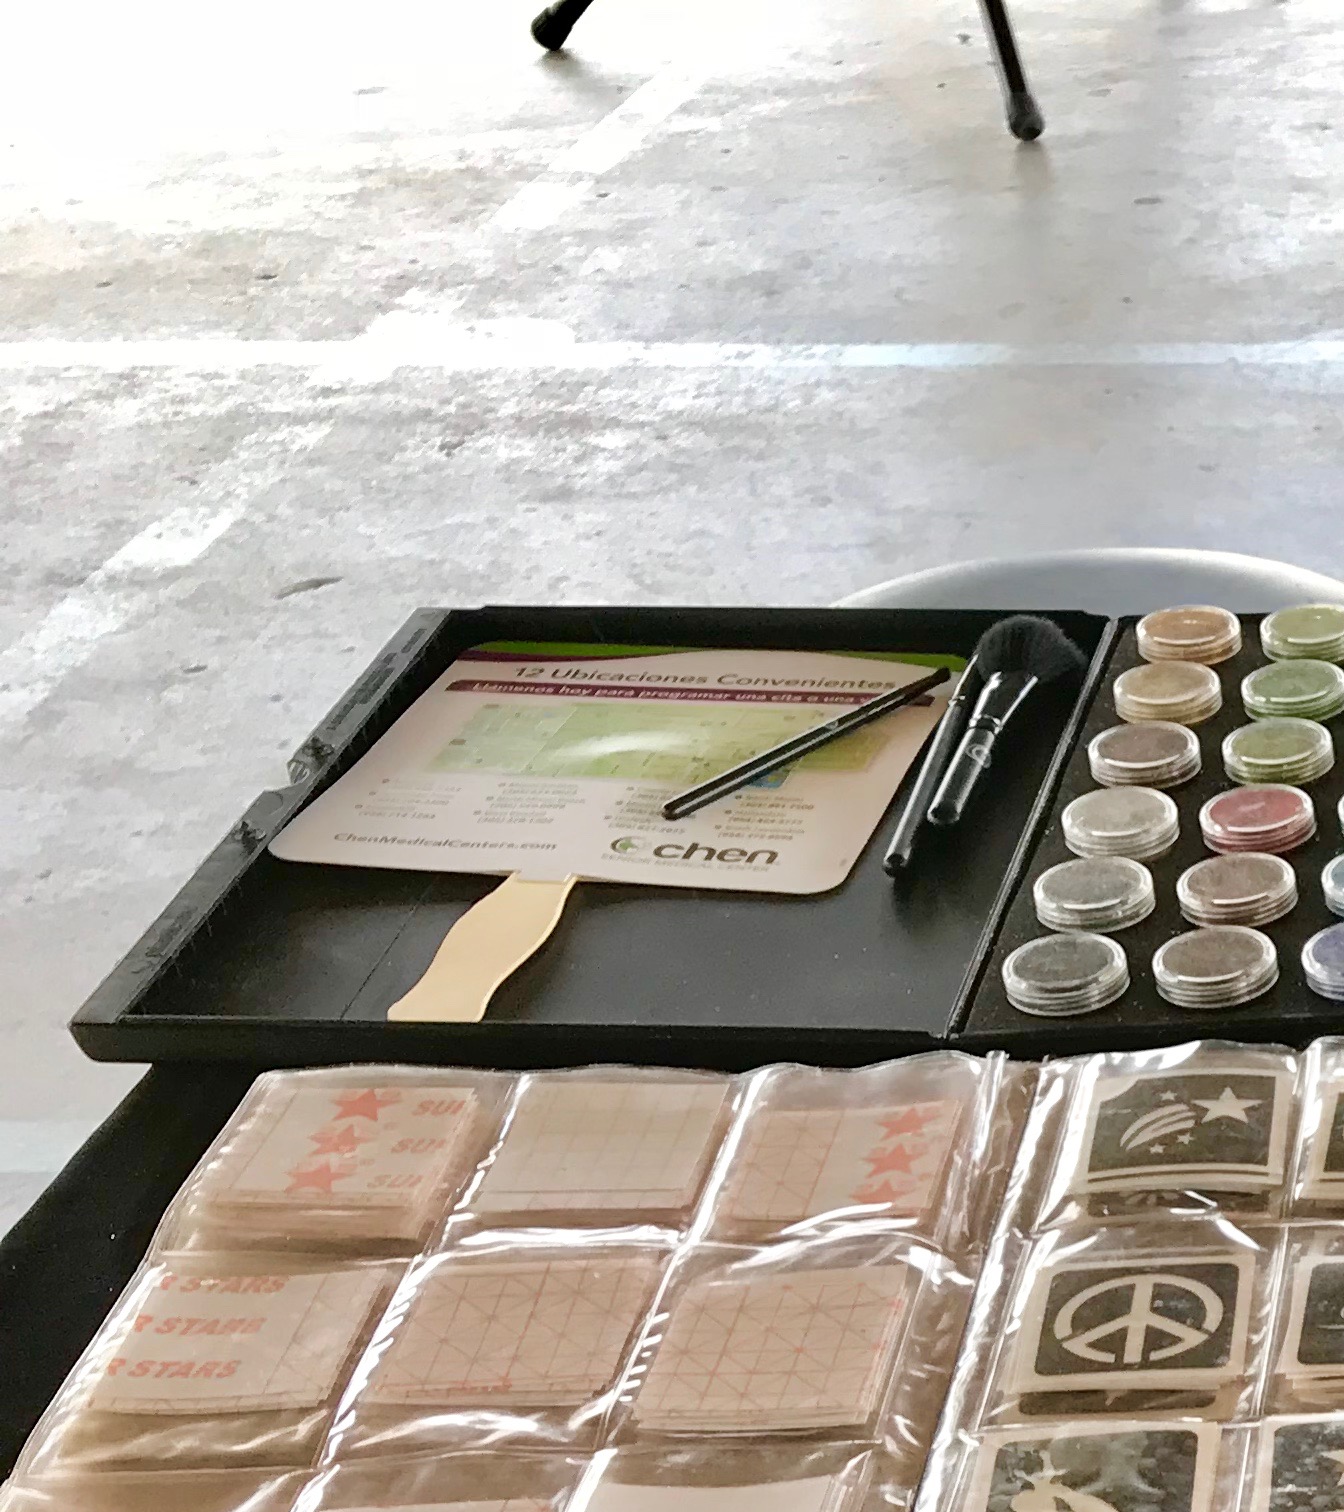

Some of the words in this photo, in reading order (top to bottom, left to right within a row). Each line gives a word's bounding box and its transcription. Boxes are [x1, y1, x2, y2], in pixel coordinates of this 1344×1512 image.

[515, 667, 545, 679] 12
[550, 667, 708, 684] Ubicaciones
[716, 673, 897, 690] Convenientes
[333, 832, 557, 851] ChenMedicalCenters.com
[653, 842, 779, 864] chen
[126, 1360, 242, 1379] STARS
